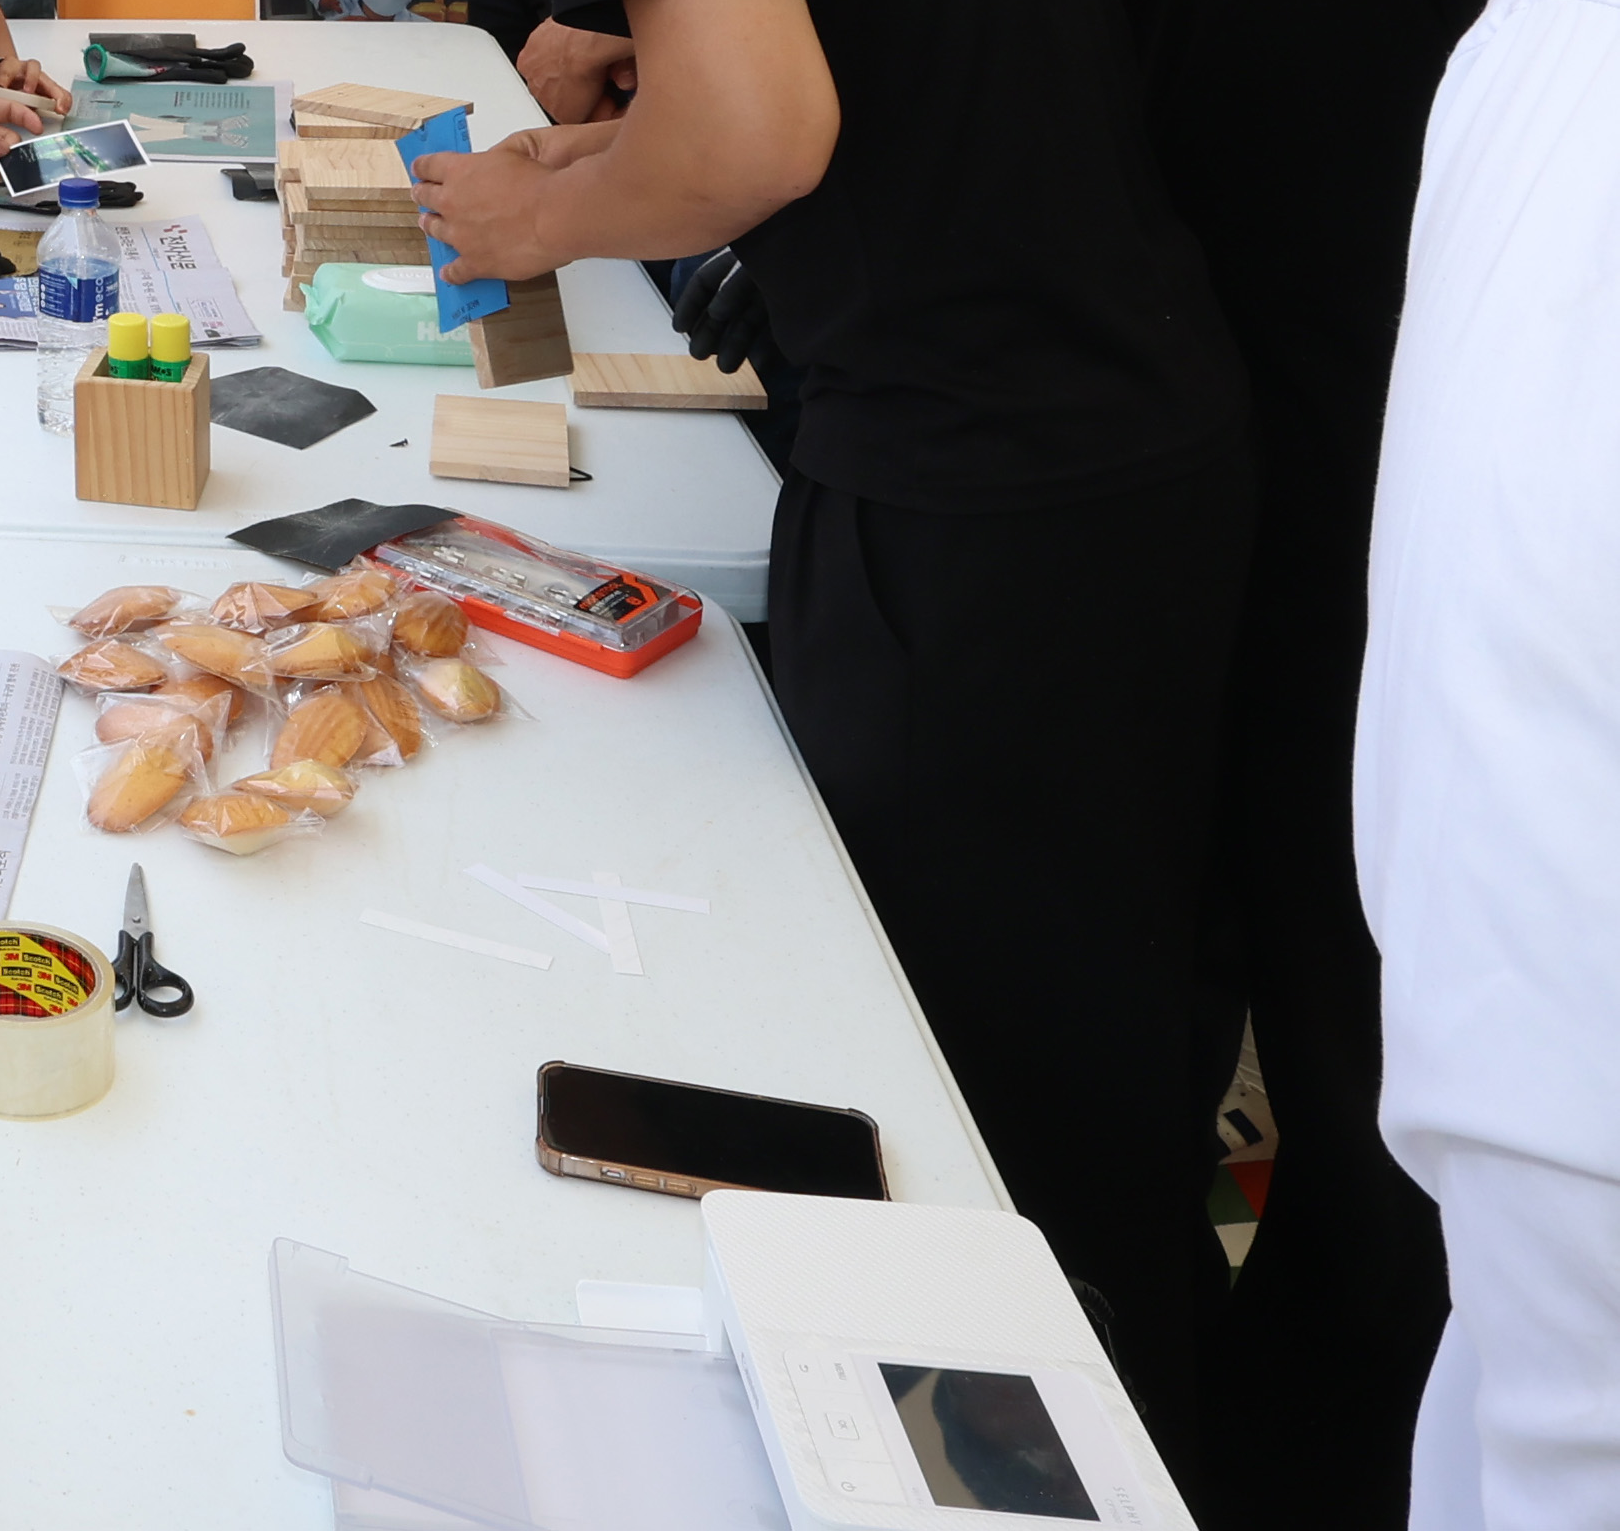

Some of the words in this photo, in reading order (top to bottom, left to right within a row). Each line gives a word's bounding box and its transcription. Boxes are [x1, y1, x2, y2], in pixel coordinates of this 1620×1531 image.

[4, 953, 19, 961] 3M
[23, 954, 51, 966] Scotch
[3, 968, 31, 976] Scotch
[37, 971, 52, 981] 3M
[16, 983, 32, 991] 3M
[35, 985, 62, 1000] Scotch
[1113, 1486, 1143, 1526] SELPHY
